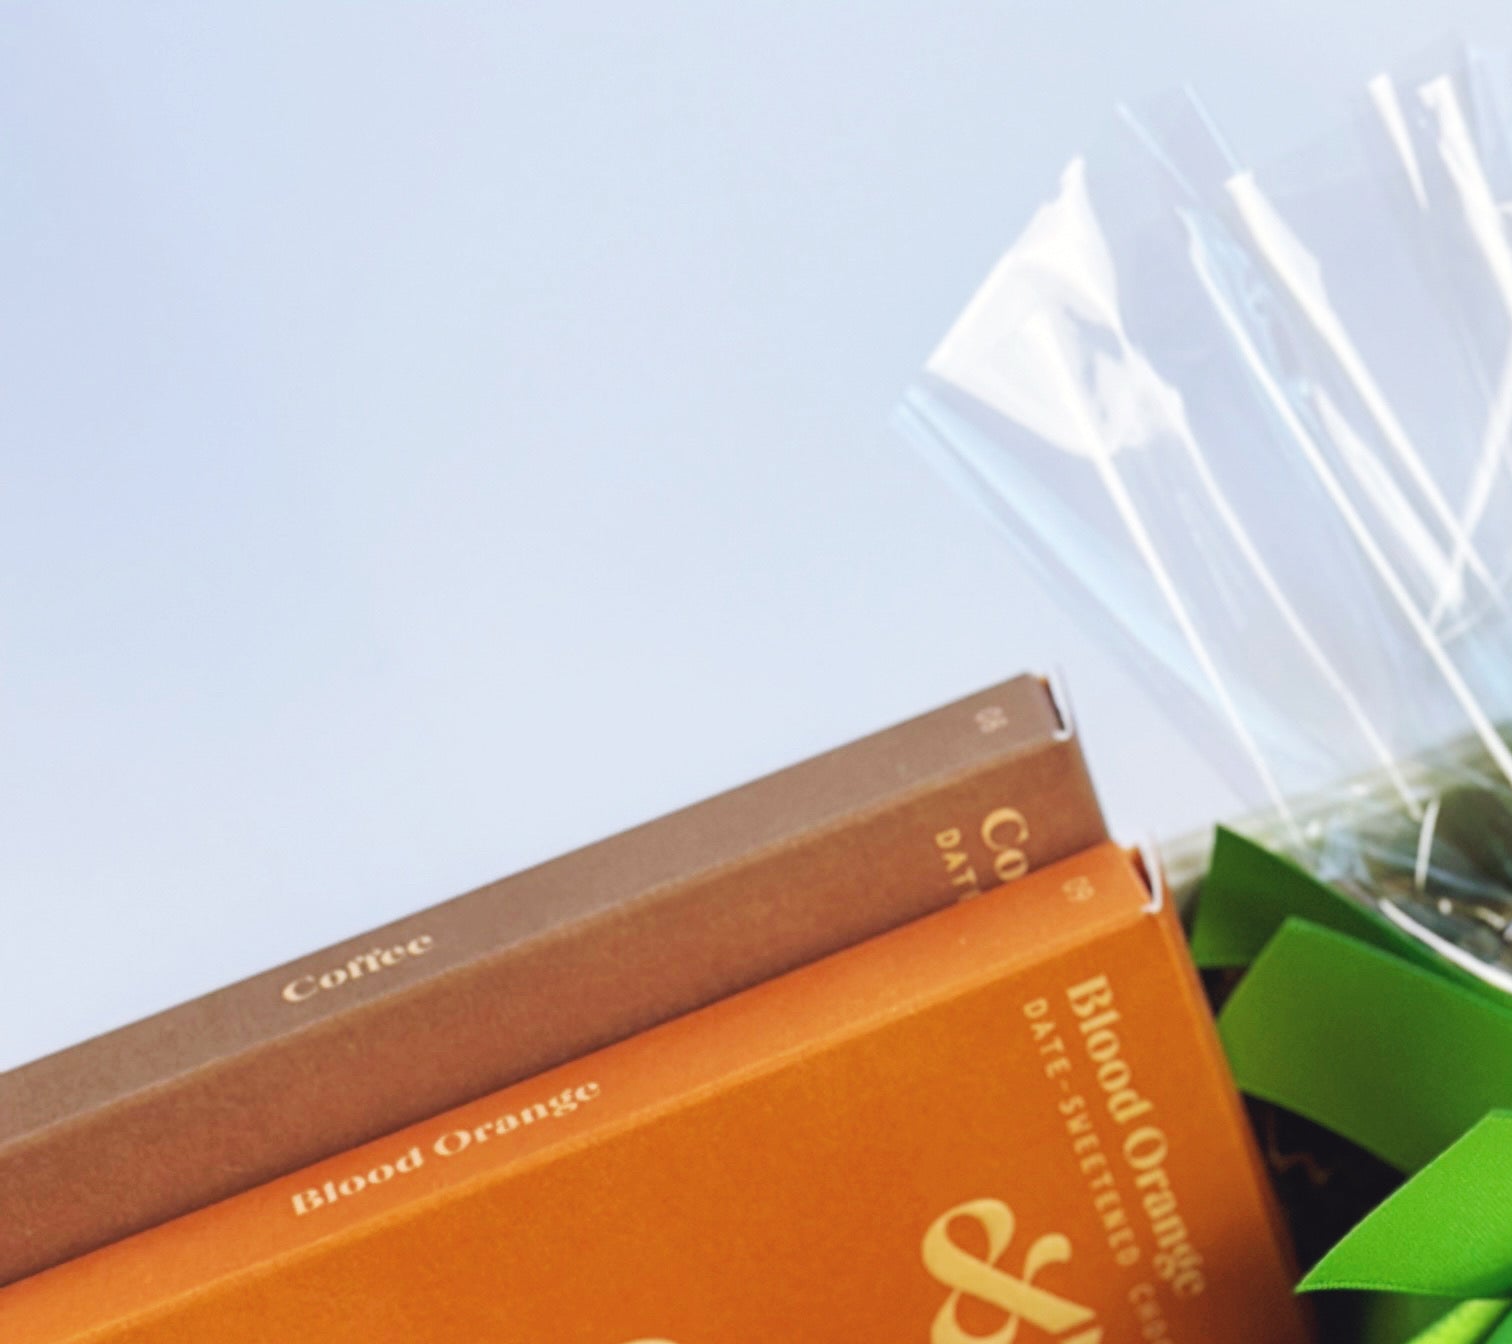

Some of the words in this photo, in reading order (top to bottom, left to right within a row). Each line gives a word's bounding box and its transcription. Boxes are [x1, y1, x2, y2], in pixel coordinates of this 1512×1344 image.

[282, 935, 433, 1002] Coffee
[290, 1145, 425, 1216] Blood
[433, 1081, 601, 1158] Orange
[1022, 996, 1143, 1268] DATE-SWEETENED
[1066, 974, 1154, 1126] Blood
[1122, 1126, 1207, 1299] Orange
